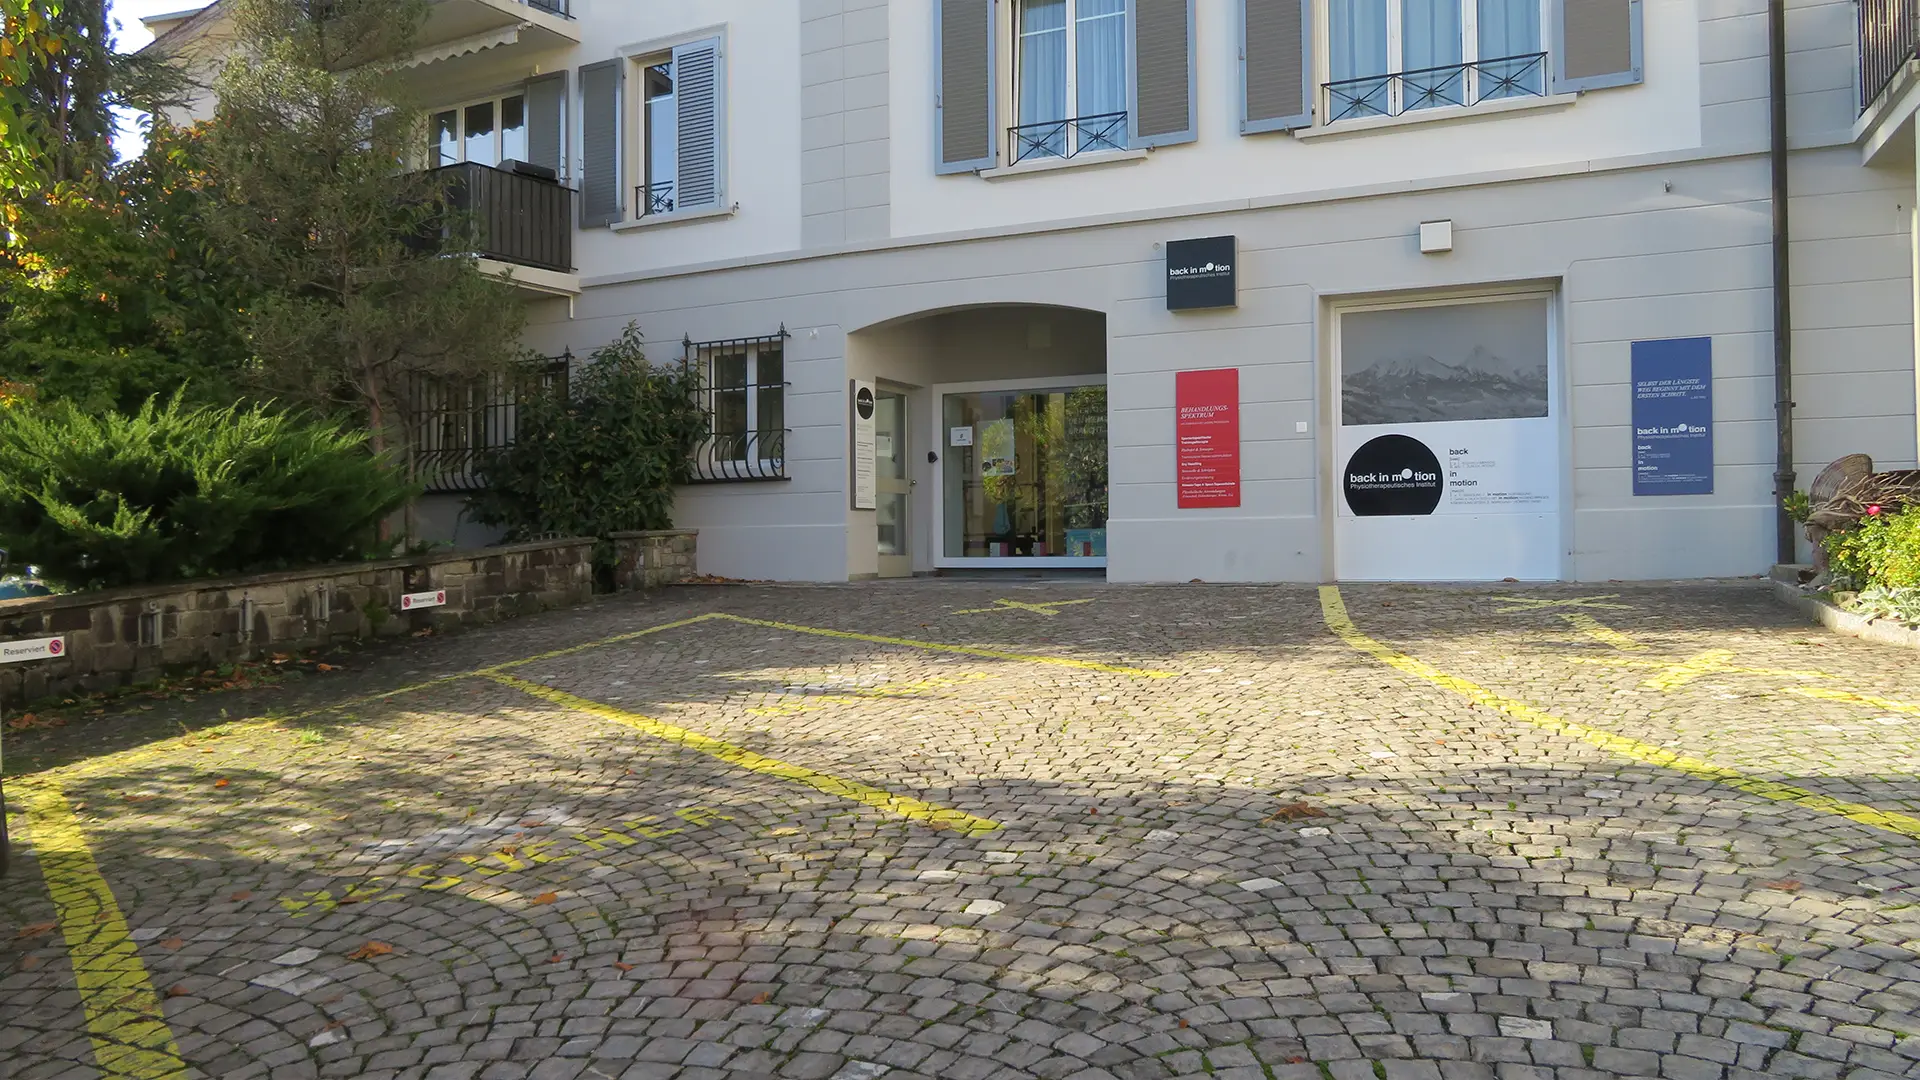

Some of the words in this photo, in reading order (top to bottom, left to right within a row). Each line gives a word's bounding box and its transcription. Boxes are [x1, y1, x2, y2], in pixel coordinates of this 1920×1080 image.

[1169, 267, 1189, 276] back
[1190, 266, 1198, 274] in
[1180, 411, 1215, 420] SPEKTRUM
[1637, 427, 1659, 435] back
[1660, 426, 1669, 434] in
[1350, 473, 1377, 483] back
[1379, 472, 1389, 482] in
[1350, 482, 1415, 491] Physiotherapeutisches
[1449, 479, 1478, 487] motion
[3, 645, 46, 656] Reserviert
